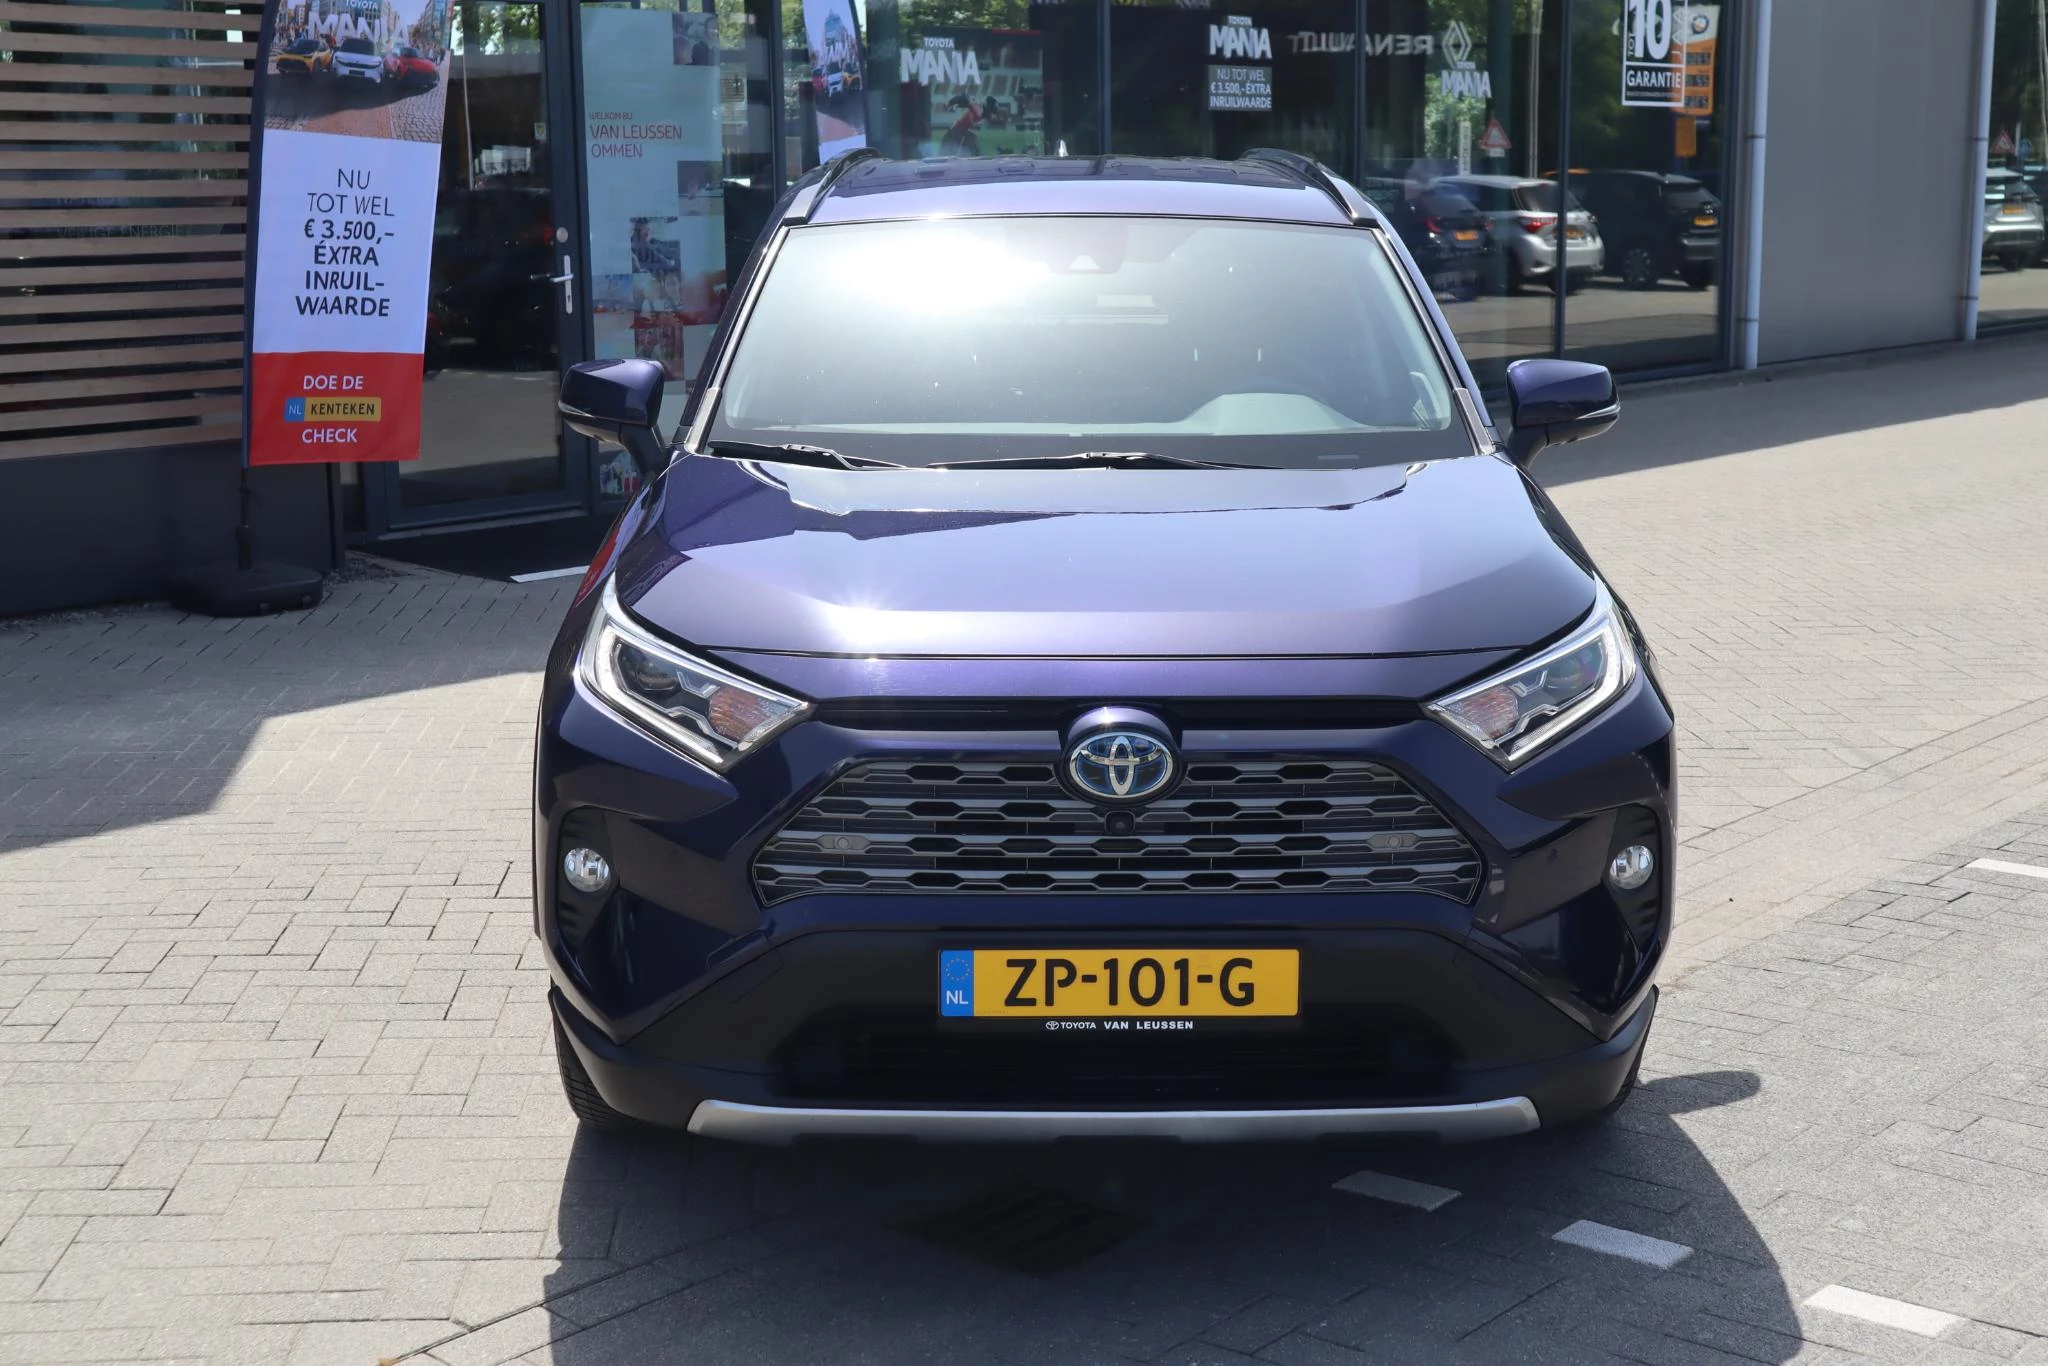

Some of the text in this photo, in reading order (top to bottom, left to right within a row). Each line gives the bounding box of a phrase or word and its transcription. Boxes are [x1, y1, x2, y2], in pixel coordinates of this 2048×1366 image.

[924, 37, 955, 49] TOYOTA
[1210, 24, 1272, 59] MANIA
[901, 48, 981, 86] MANIA
[1217, 68, 1265, 81] NU TOT WEL
[1441, 70, 1492, 98] MANIA
[1626, 70, 1681, 88] GARANTIE
[1210, 95, 1272, 109] INRUILWAARDE
[590, 124, 682, 140] VAN LEUSSEN
[591, 143, 643, 158] OMMEN
[337, 168, 371, 190] NU
[307, 192, 395, 217] TOT WEL
[304, 218, 315, 238] €
[305, 270, 385, 291] INRUIL-
[295, 295, 390, 317] WAARDE
[303, 375, 364, 391] DOE DE
[288, 402, 375, 416] NL KENTEKEN
[301, 428, 358, 444] CHECK
[946, 957, 1255, 1007] NL ZP-101-G
[1060, 1021, 1194, 1030] TOYOTA VAN LEUSSEN
